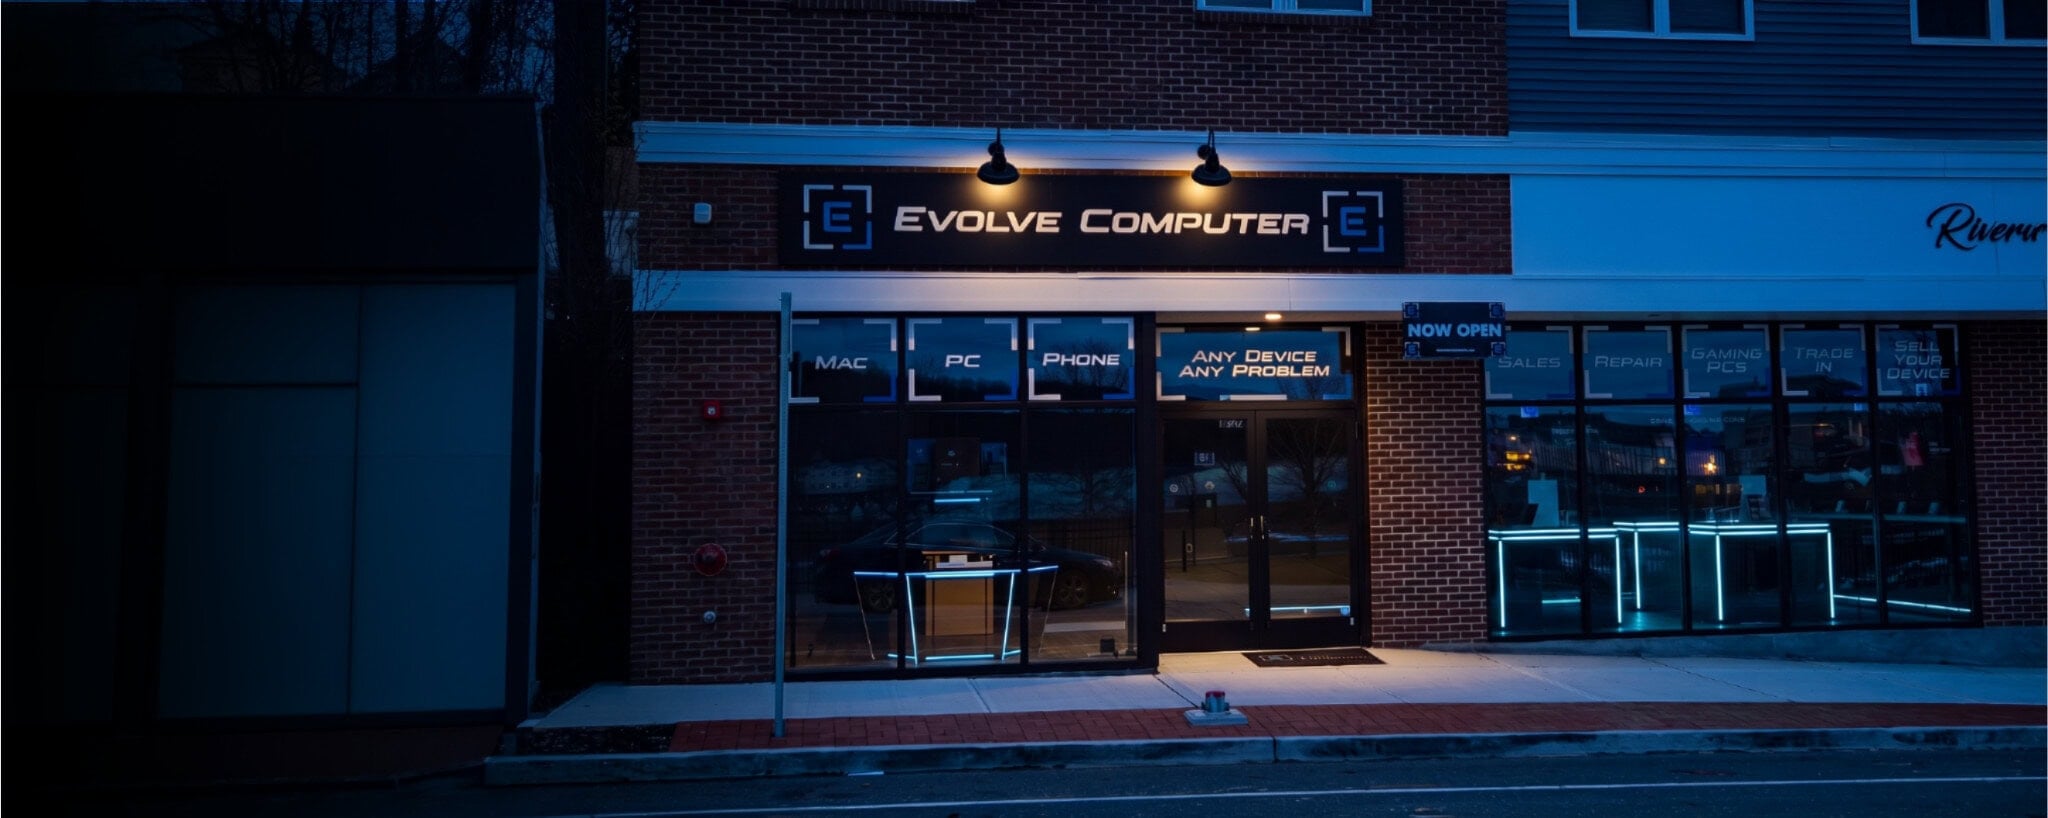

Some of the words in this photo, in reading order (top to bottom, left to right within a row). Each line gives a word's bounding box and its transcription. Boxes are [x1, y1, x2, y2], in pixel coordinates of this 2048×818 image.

[822, 200, 853, 233] E
[893, 205, 1063, 233] EVOLVE
[1079, 208, 1310, 235] COMPUTER
[1339, 205, 1368, 237] E
[1407, 323, 1453, 337] NOW
[1457, 323, 1502, 337] OPEN
[1893, 339, 1941, 352] SELL
[1042, 352, 1121, 367] PHONE
[1191, 350, 1238, 363] ANY
[1244, 349, 1317, 363] DEVICE
[1691, 347, 1762, 360] GAMING
[1794, 346, 1855, 360] TRADE
[1893, 353, 1943, 366] YOUR
[813, 355, 869, 370] MAC
[944, 353, 982, 368] PC
[1498, 356, 1561, 369] SALES
[1594, 355, 1663, 369] REPAIR
[1706, 361, 1748, 374] PCS
[1815, 361, 1833, 373] IN
[1178, 364, 1225, 378] ANY
[1231, 364, 1330, 378] PROBLEM
[1886, 367, 1952, 380] DEVICE
